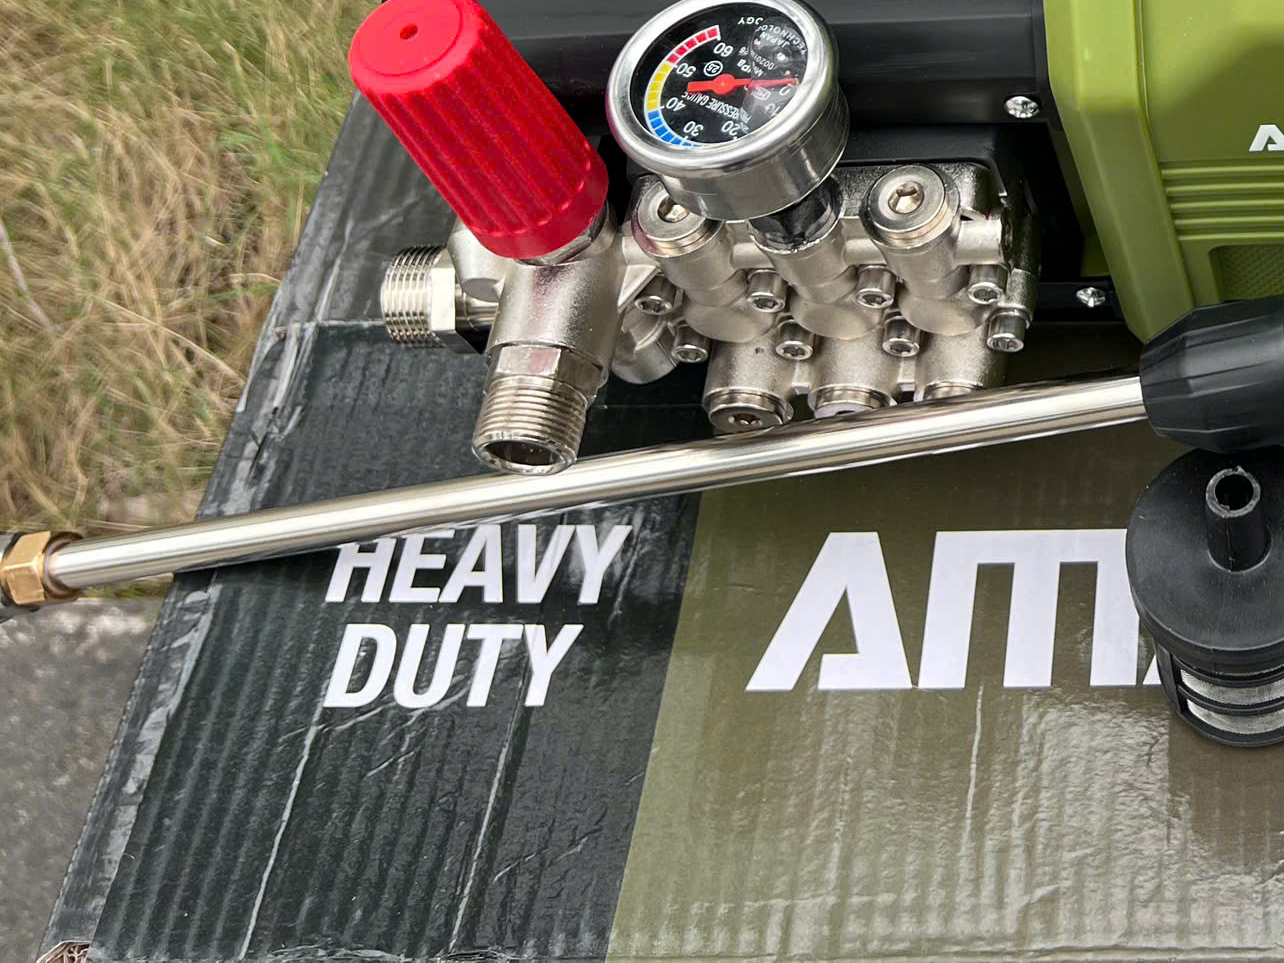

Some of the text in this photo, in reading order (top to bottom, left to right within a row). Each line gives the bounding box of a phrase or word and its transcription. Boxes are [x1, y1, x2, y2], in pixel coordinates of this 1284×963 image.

[759, 32, 791, 48] JAPAN
[713, 42, 734, 58] 60
[676, 63, 696, 78] 50
[665, 97, 687, 112] 40
[683, 121, 704, 136] 30
[721, 120, 741, 136] 20
[325, 524, 631, 605] HEAVY
[323, 624, 583, 708] DUTY
